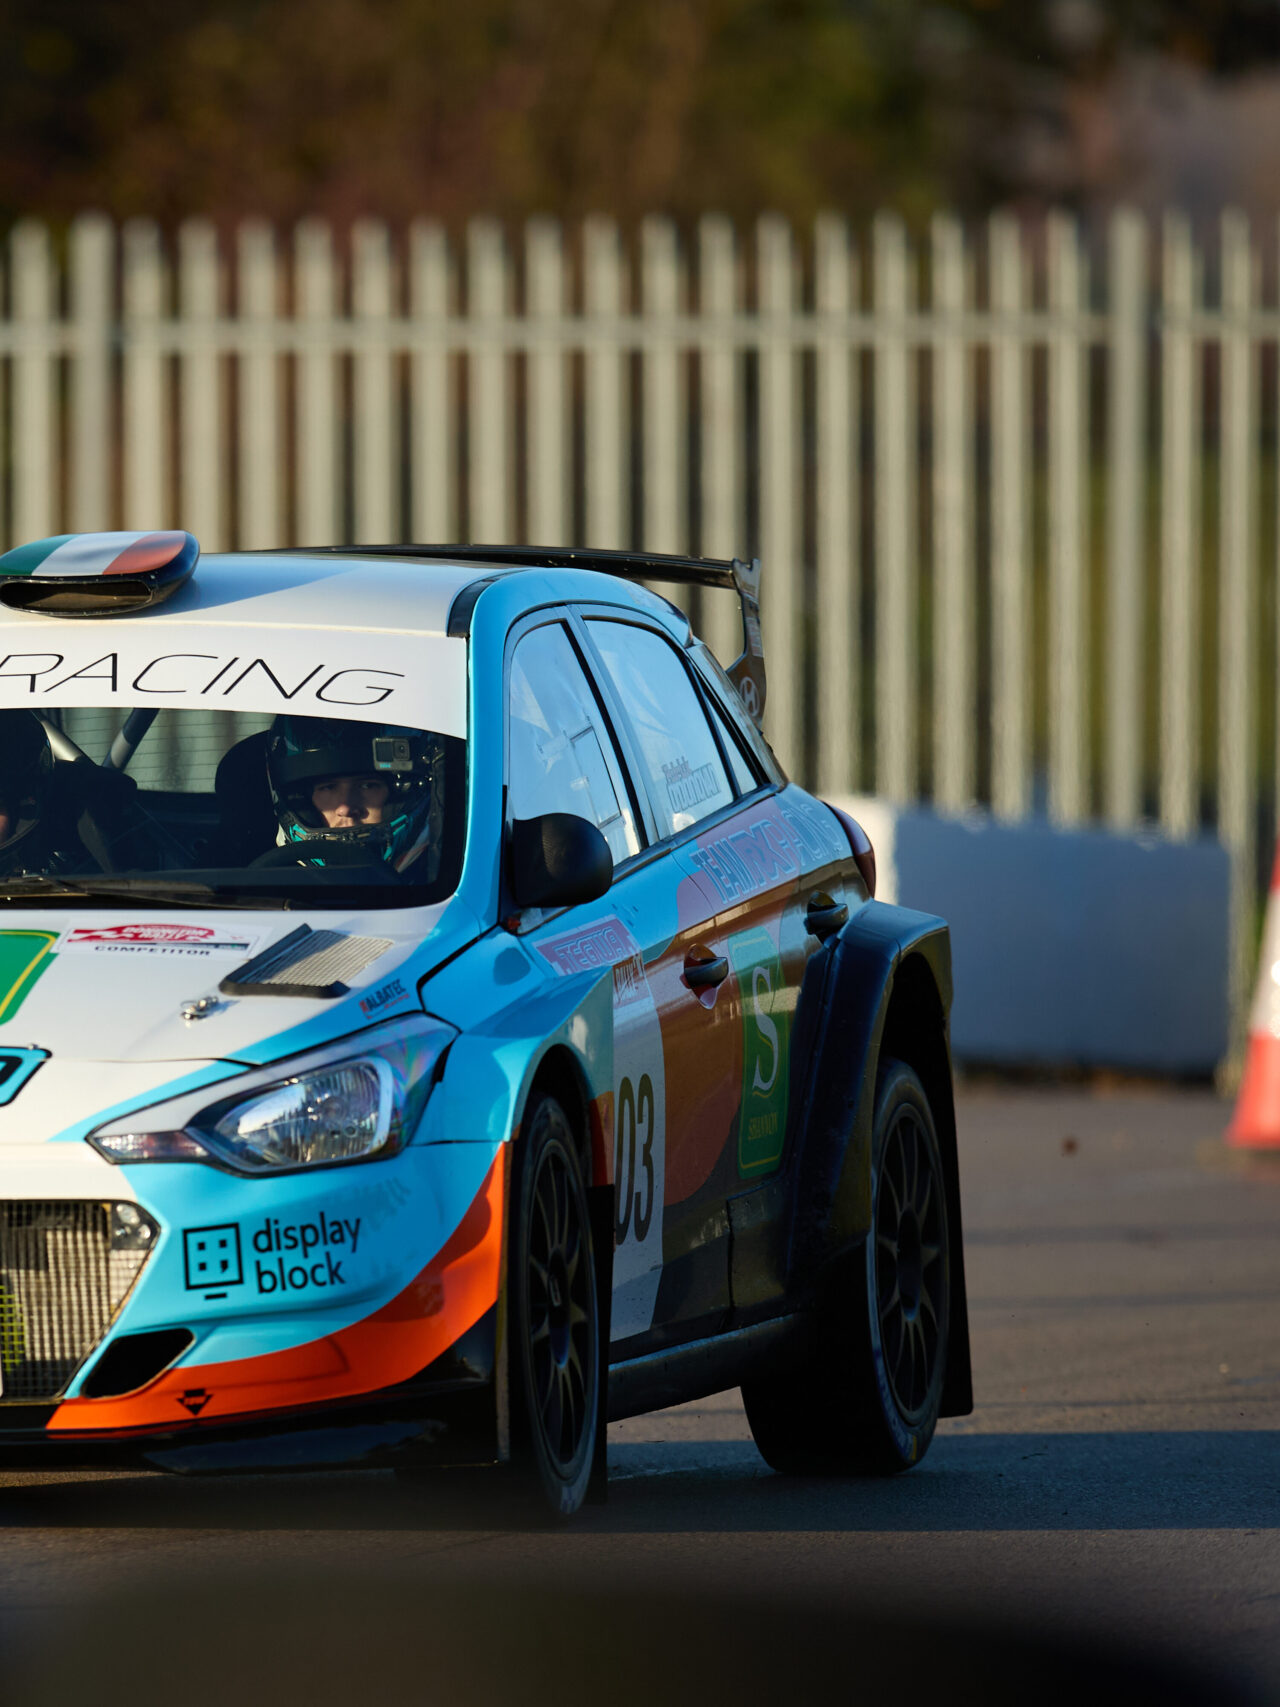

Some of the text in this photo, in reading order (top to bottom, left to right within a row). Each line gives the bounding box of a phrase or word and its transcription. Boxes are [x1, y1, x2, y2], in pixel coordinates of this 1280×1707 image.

[689, 803, 844, 904] TEAM RX RACING
[94, 945, 211, 956] COMPETITOR
[552, 926, 627, 976] TEGIWA
[253, 1211, 361, 1259] display
[255, 1251, 346, 1294] block
